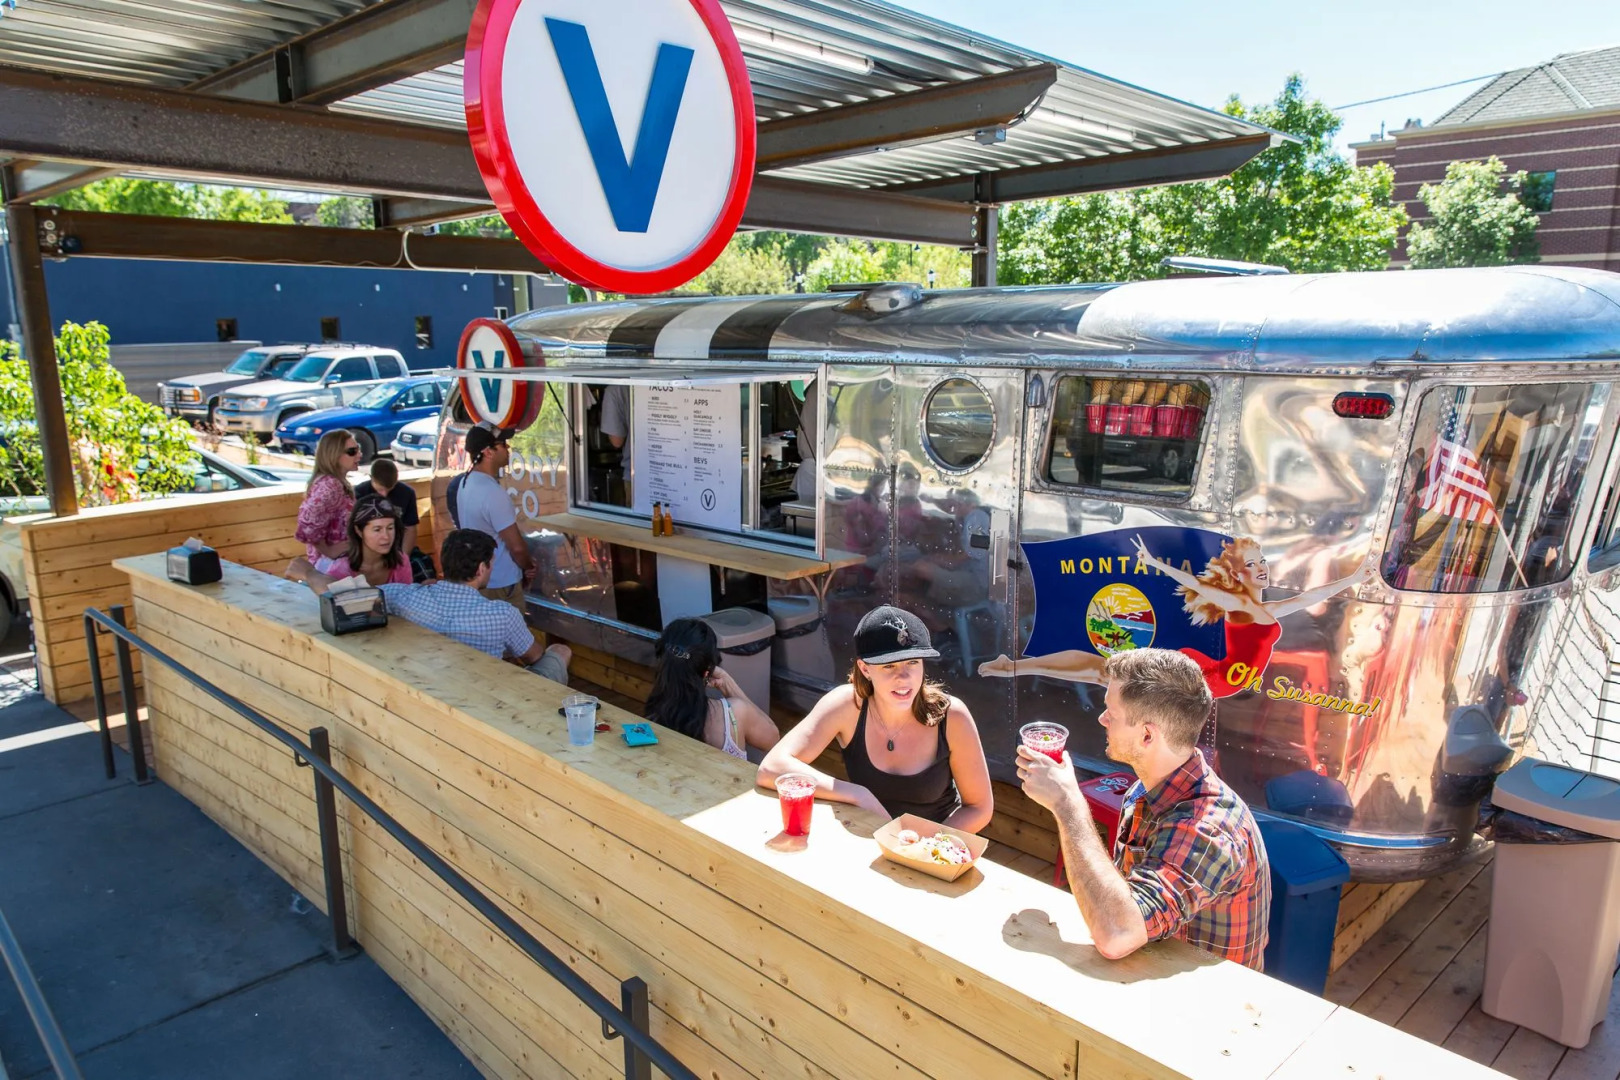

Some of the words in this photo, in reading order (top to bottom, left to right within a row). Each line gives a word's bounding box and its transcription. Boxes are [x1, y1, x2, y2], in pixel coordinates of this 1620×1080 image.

[543, 16, 696, 234] V
[471, 350, 505, 413] V
[694, 399, 709, 407] APPS
[499, 451, 561, 488] ORY
[693, 456, 708, 465] BEVS
[704, 493, 713, 507] V
[1060, 556, 1194, 576] MONTANA
[1226, 662, 1264, 693] Oh
[1267, 676, 1382, 717] Susanna!
